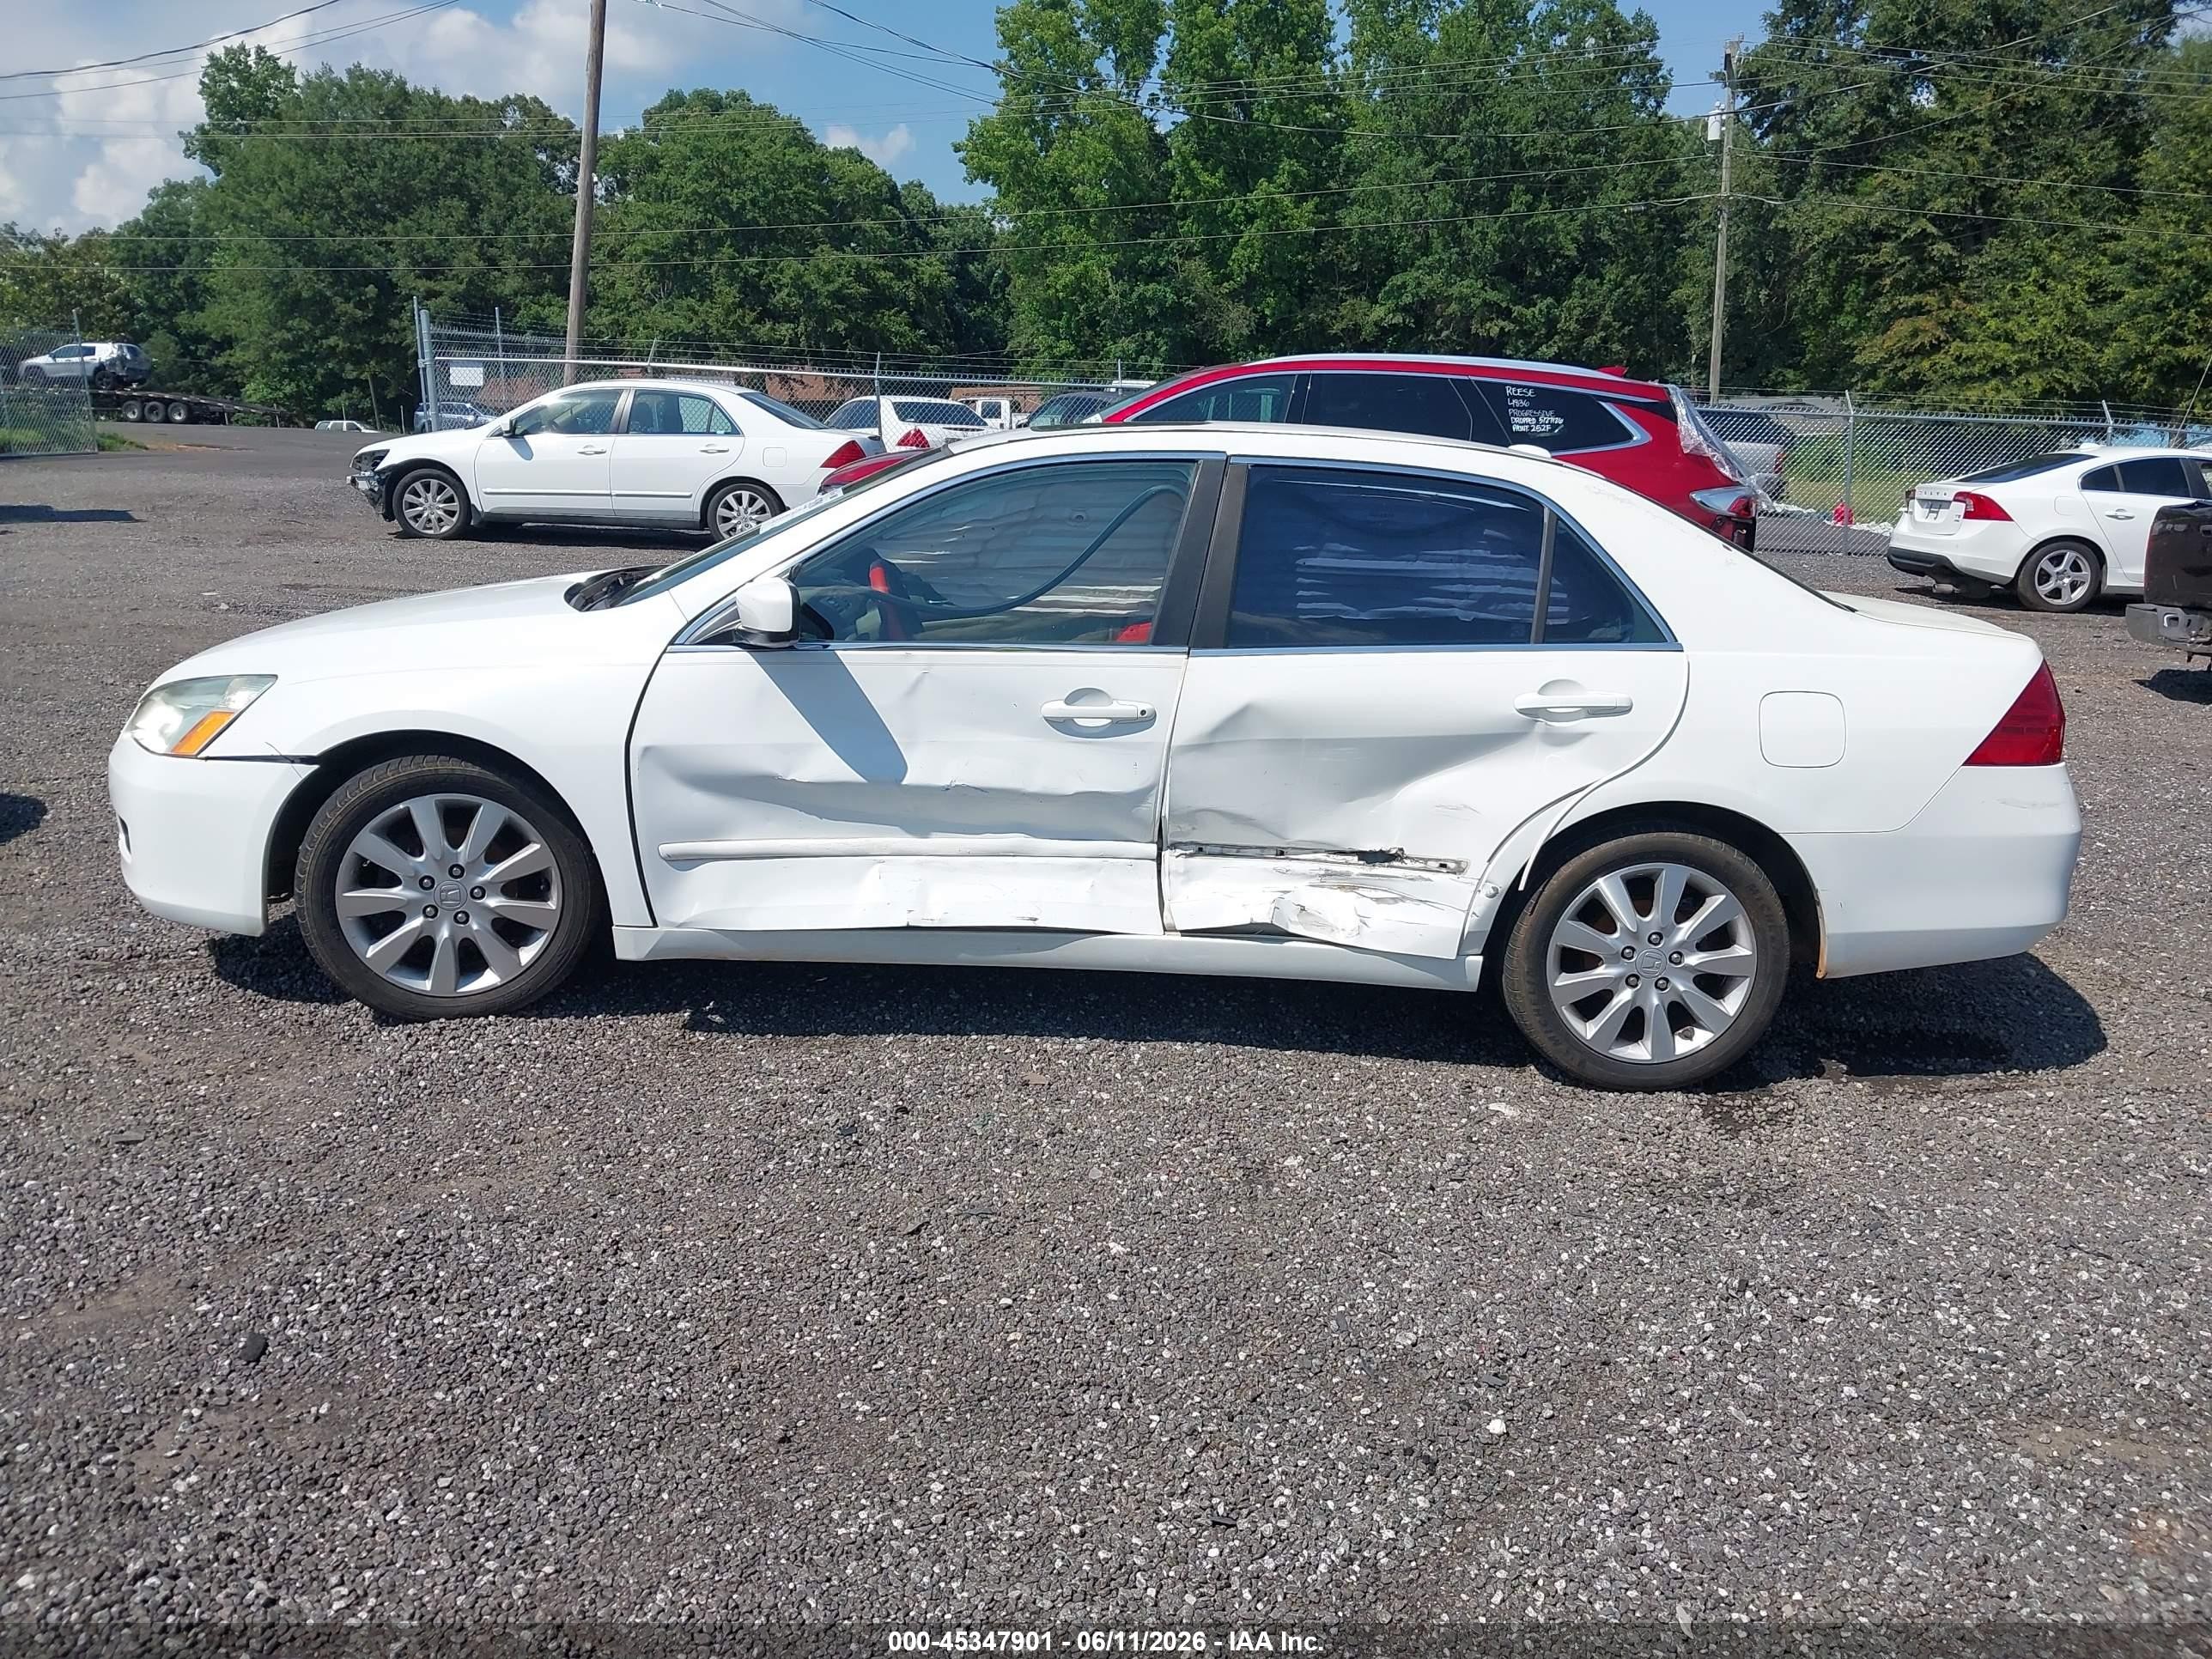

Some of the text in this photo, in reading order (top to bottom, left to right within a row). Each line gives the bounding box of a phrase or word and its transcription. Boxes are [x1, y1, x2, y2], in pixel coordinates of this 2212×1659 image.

[1505, 386, 1537, 397] REESE
[1508, 398, 1530, 408] 4836
[1508, 408, 1556, 417] PROGRESSIVE
[1530, 424, 1552, 433] 252F
